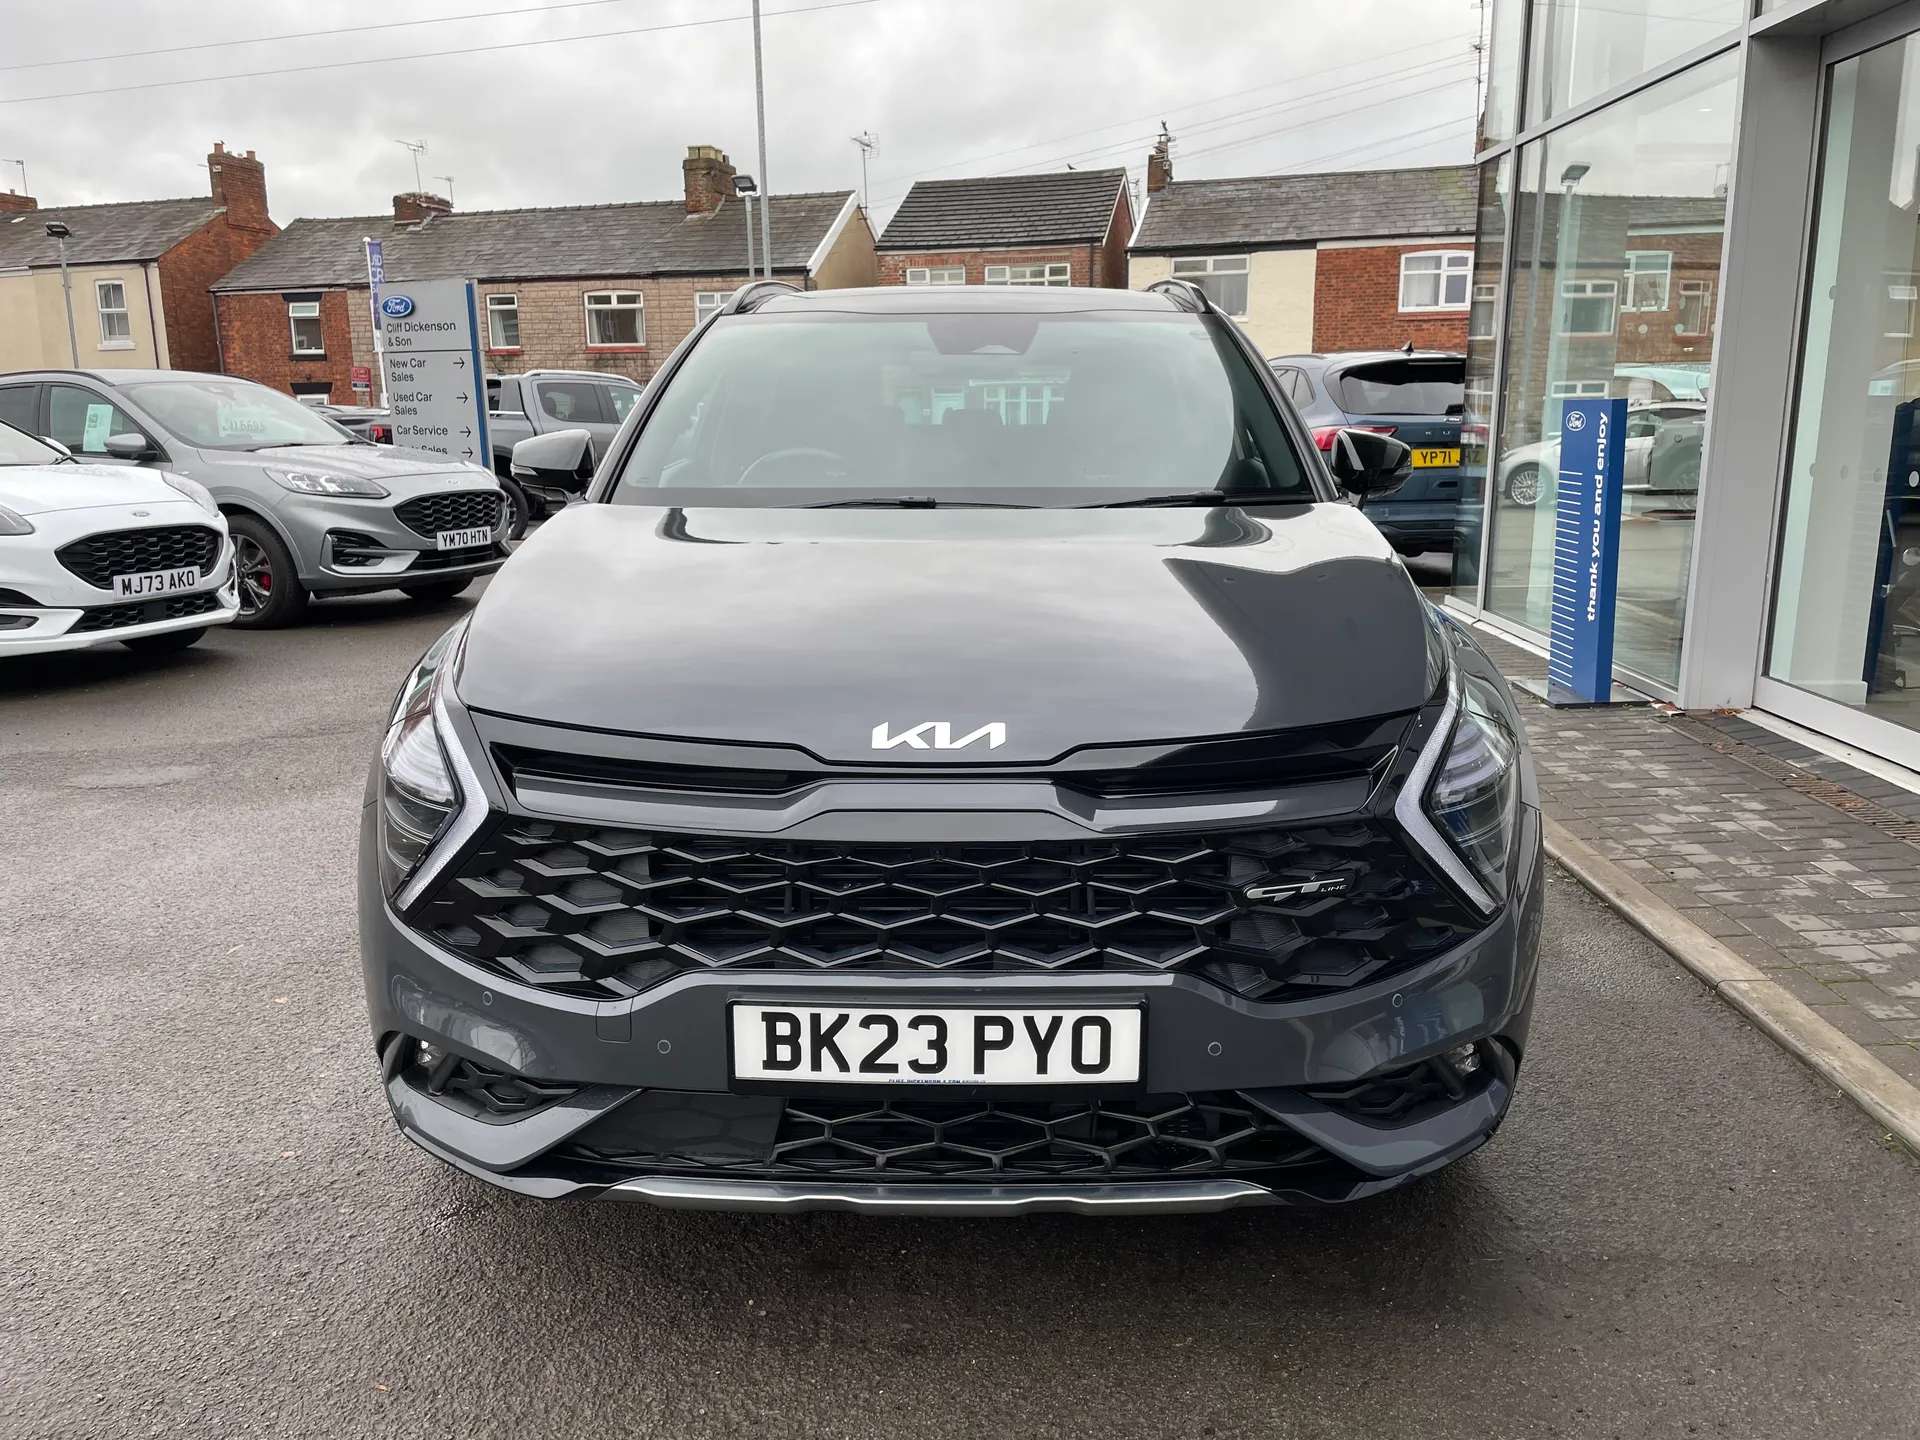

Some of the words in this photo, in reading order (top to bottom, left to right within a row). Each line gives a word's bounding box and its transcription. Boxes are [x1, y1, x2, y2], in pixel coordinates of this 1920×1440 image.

[386, 322, 403, 333] Cliff
[404, 321, 456, 333] Dickenson
[387, 336, 394, 347] &
[395, 336, 412, 347] Son
[389, 358, 408, 369] New
[409, 357, 426, 368] Car
[391, 371, 415, 382] Sales
[393, 391, 414, 402] Used
[415, 391, 433, 402] Car
[394, 404, 418, 416] Sales
[396, 424, 411, 436] Car
[412, 424, 448, 436] Service
[1596, 412, 1609, 473] enjoy
[1420, 450, 1453, 465] YP71
[1594, 475, 1604, 516] and
[441, 531, 469, 547] YM70
[470, 528, 488, 545] HTN
[1590, 519, 1601, 559] you
[121, 574, 164, 596] MJ73
[169, 570, 195, 590] AKO
[1587, 561, 1600, 622] thank
[871, 721, 1006, 750] KIA
[760, 1011, 948, 1074] BK23
[973, 1014, 1112, 1075] PYO
